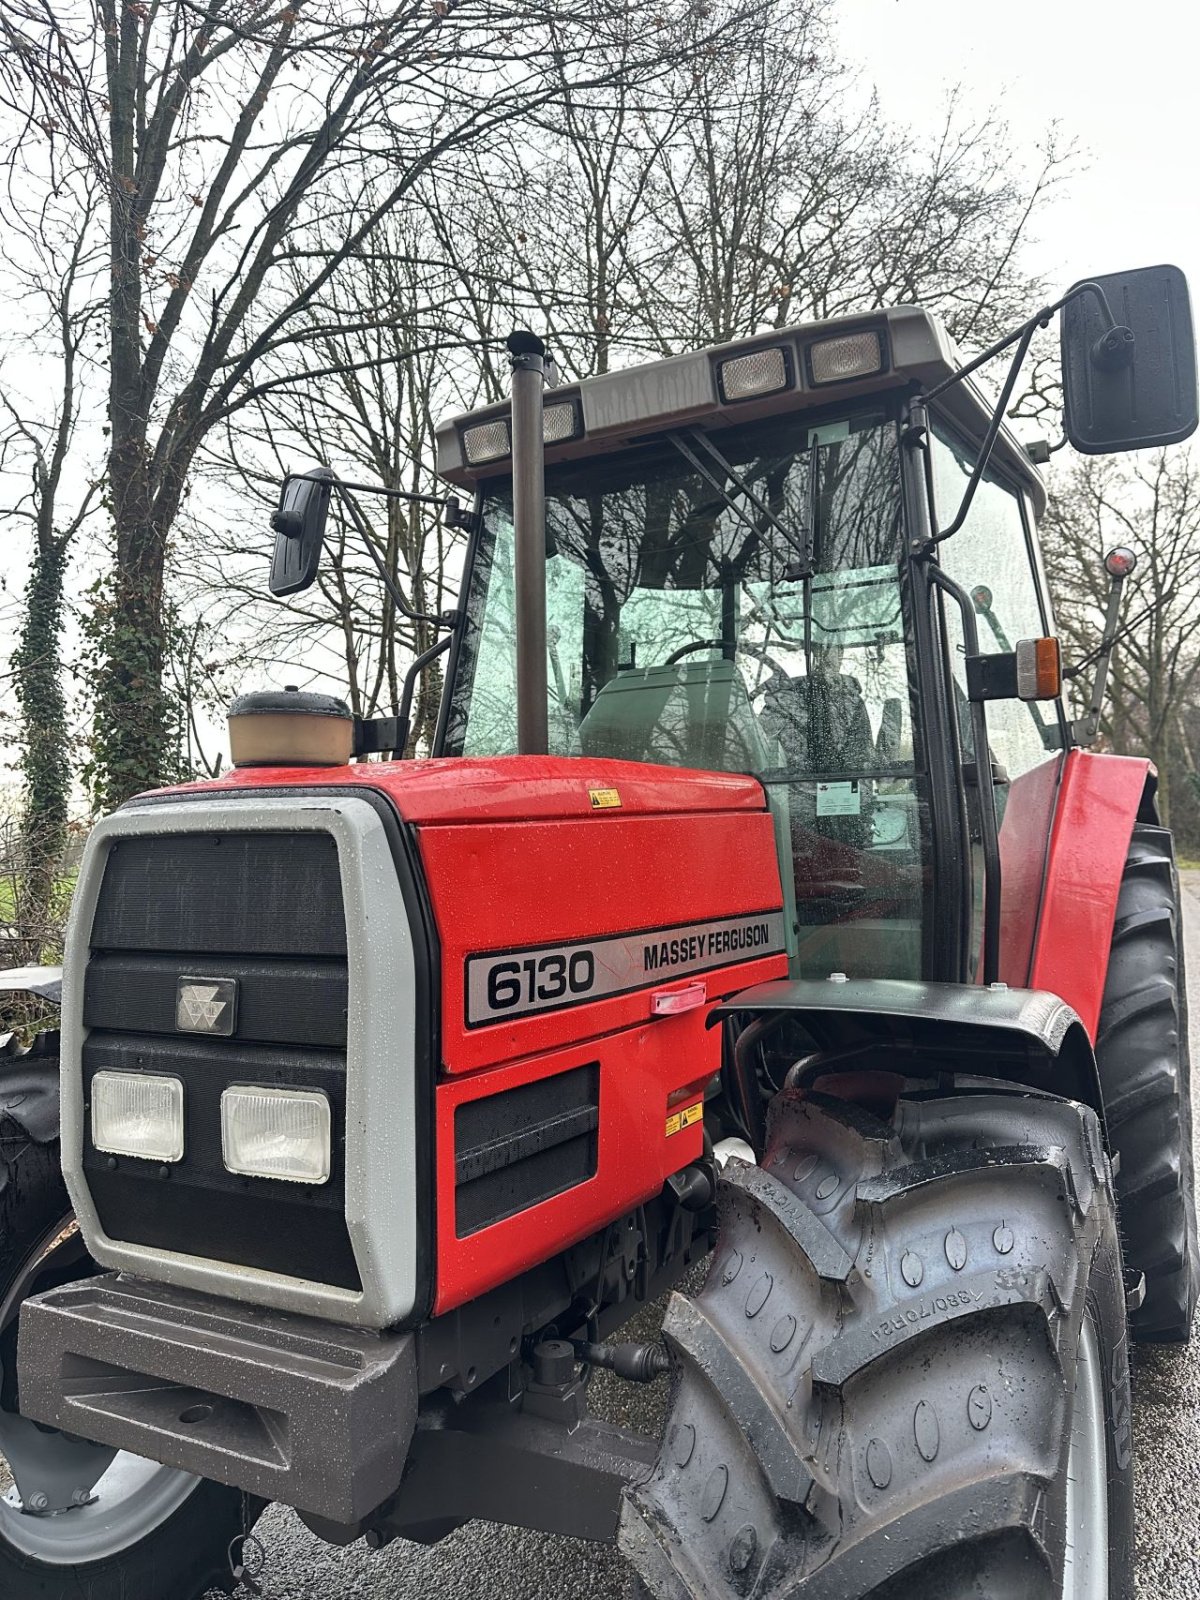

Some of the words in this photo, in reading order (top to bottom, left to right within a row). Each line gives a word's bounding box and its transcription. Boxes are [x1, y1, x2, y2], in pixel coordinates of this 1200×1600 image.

[644, 935, 706, 971] MASSEY
[708, 923, 769, 956] FERGUSON
[487, 950, 595, 1010] 6130
